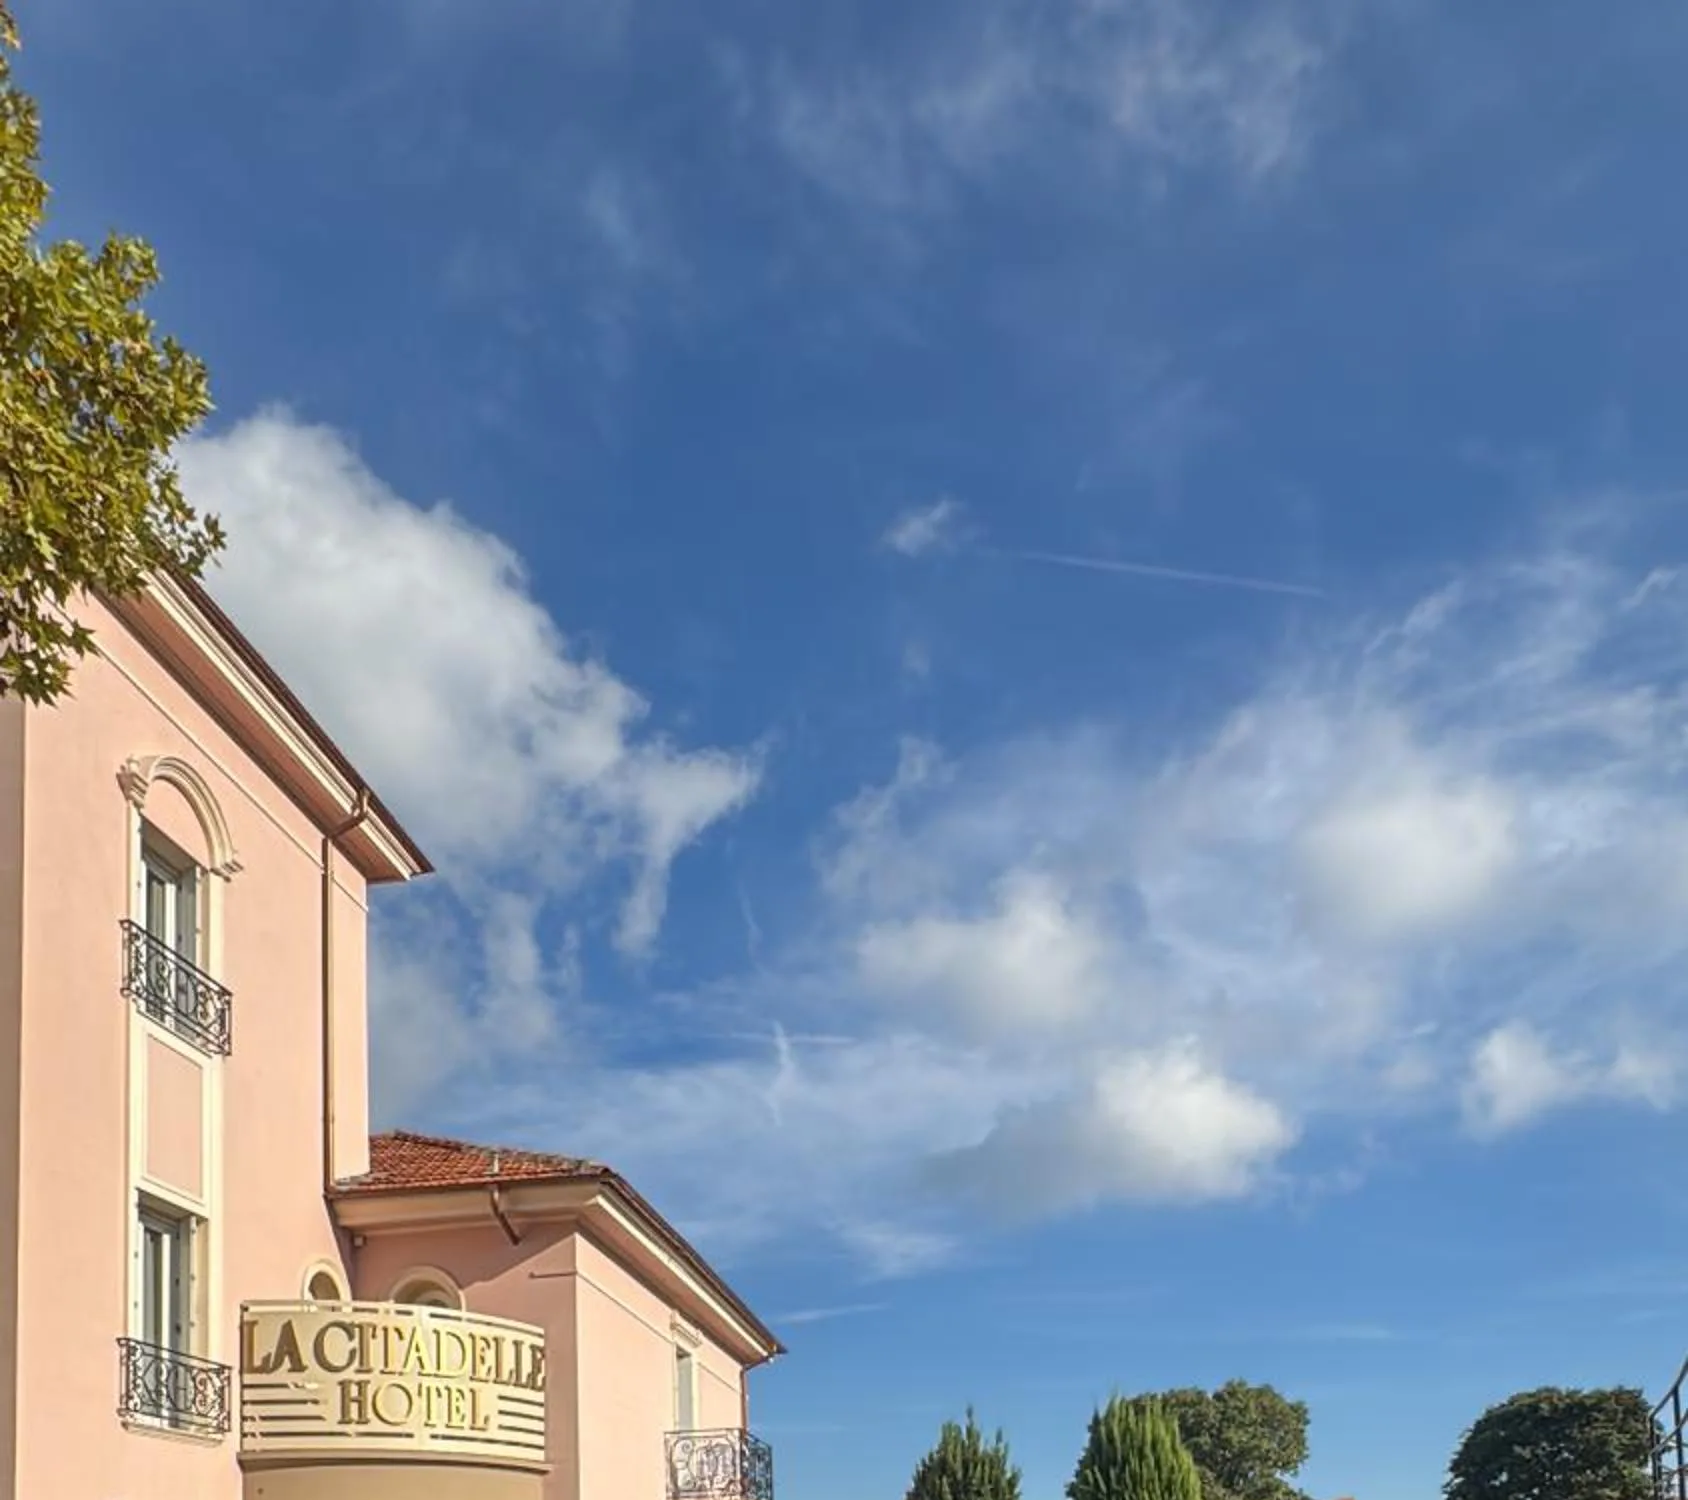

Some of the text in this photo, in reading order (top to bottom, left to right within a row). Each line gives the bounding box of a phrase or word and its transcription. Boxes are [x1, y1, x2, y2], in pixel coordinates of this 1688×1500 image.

[241, 1319, 545, 1392] LA CITADELLE
[337, 1379, 491, 1431] HOTEL
